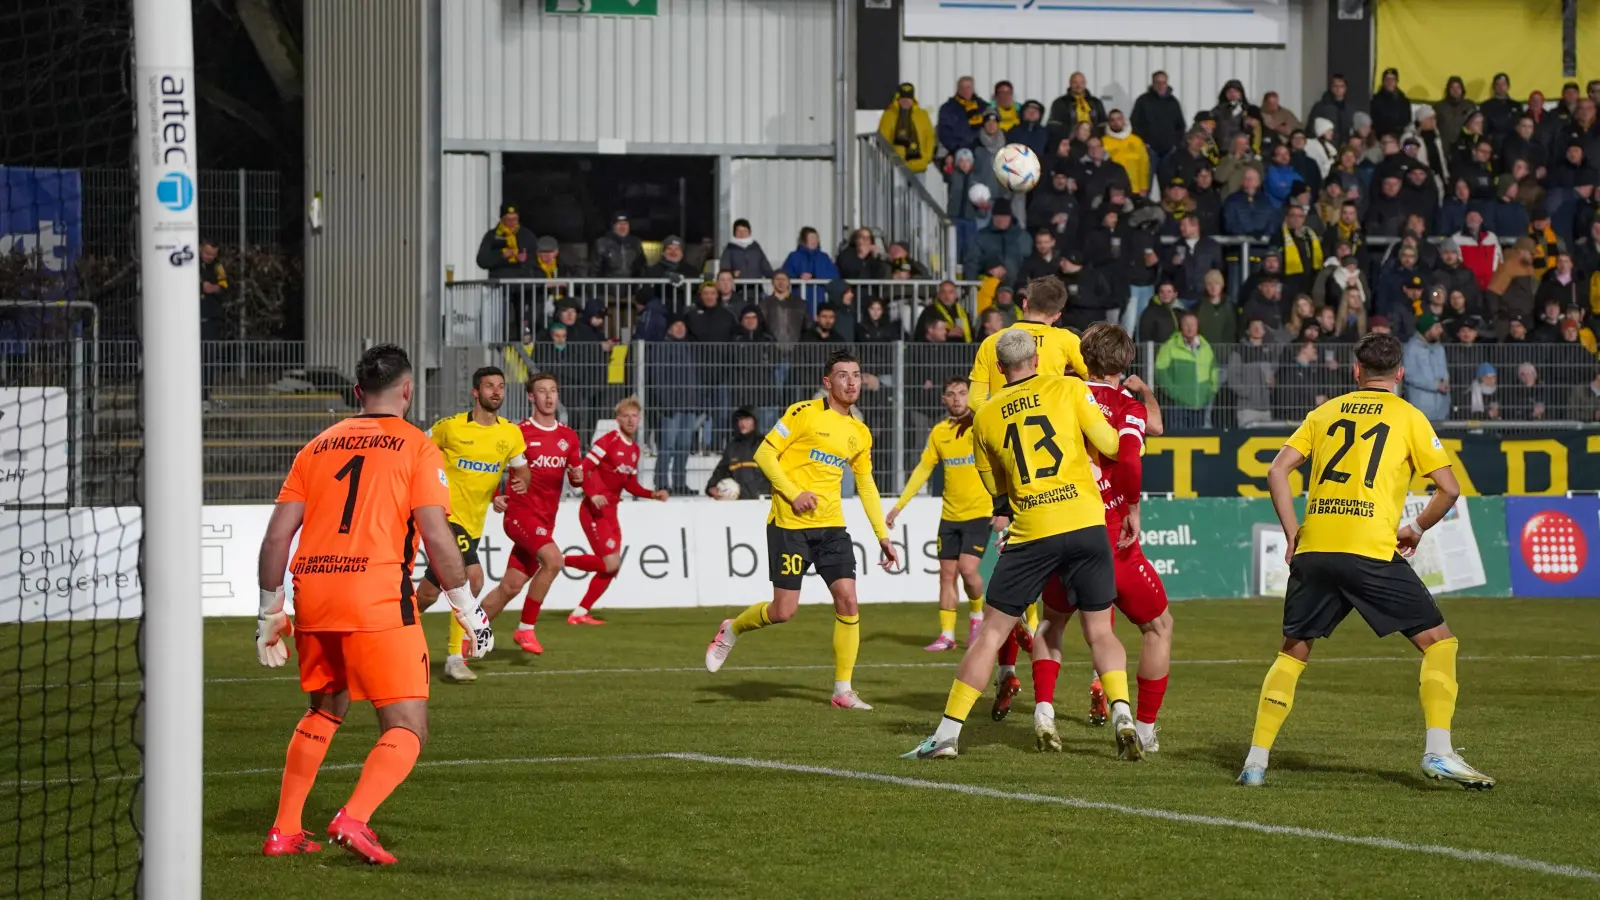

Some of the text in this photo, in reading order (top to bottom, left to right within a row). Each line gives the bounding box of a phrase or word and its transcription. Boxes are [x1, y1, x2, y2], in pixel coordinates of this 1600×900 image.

[161, 74, 190, 165] artec
[169, 245, 194, 267] GS
[1001, 394, 1041, 419] EBERLE
[1340, 402, 1384, 415] WEBER
[1003, 414, 1064, 485] 13
[1318, 418, 1391, 489] 21
[457, 457, 502, 474] maxit
[530, 454, 567, 469] AKON
[334, 454, 366, 534] 1
[1023, 483, 1077, 501] BAYREUTHER
[1027, 490, 1080, 509] BRAUHAUS
[1317, 506, 1375, 518] BRAUHAUS
[1318, 498, 1375, 510] BAYREUTHER
[20, 543, 84, 571] only
[307, 554, 370, 566] BAYREUTHER
[781, 553, 804, 576] 30
[304, 563, 369, 575] BRAUHAUS
[421, 652, 430, 685] 1
